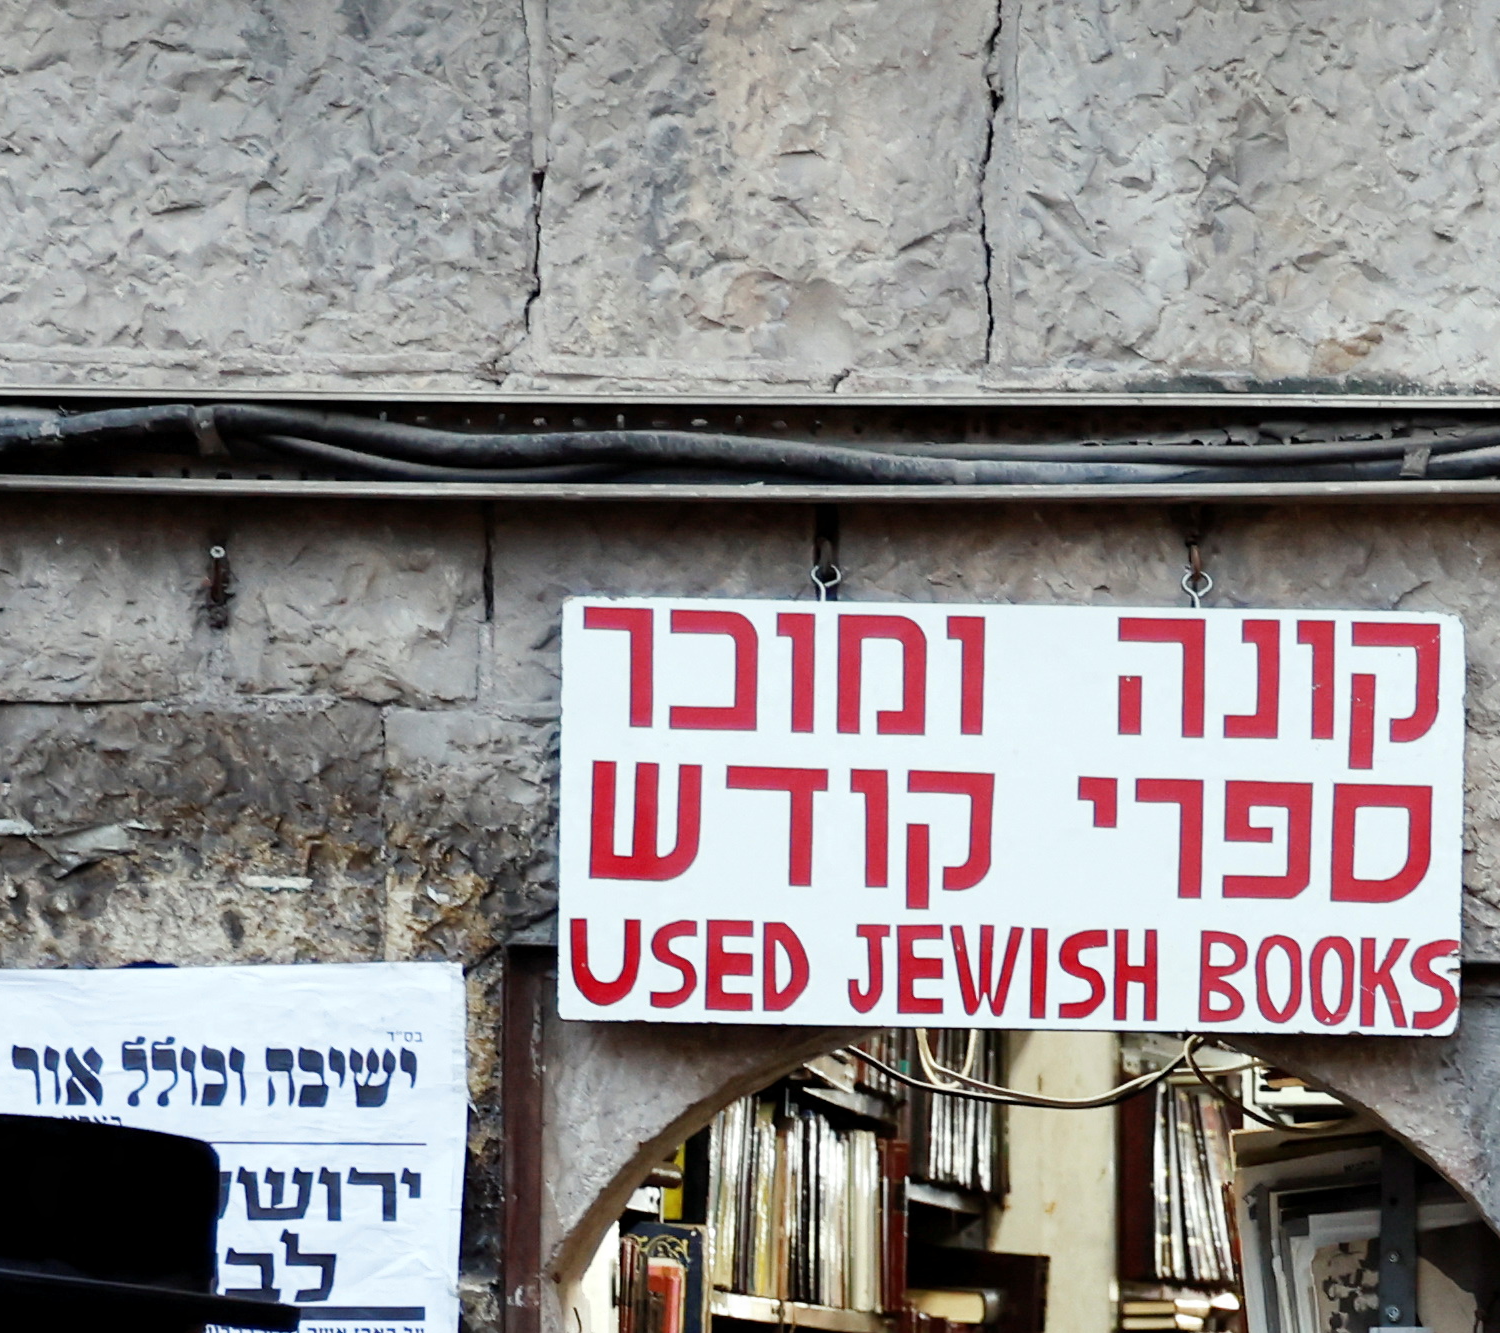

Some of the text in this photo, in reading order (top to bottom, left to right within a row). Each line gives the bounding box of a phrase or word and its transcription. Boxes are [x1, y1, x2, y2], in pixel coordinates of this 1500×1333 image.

[583, 605, 1441, 770] קונה ומוכר
[588, 759, 1433, 910] ספרי קודש
[569, 916, 1462, 1030] USED JEWISH BOOKS
[11, 1044, 104, 1107] אור
[121, 1036, 247, 1108] וכולל
[265, 1045, 418, 1108] ישיבה
[215, 1165, 422, 1222] ירוש
